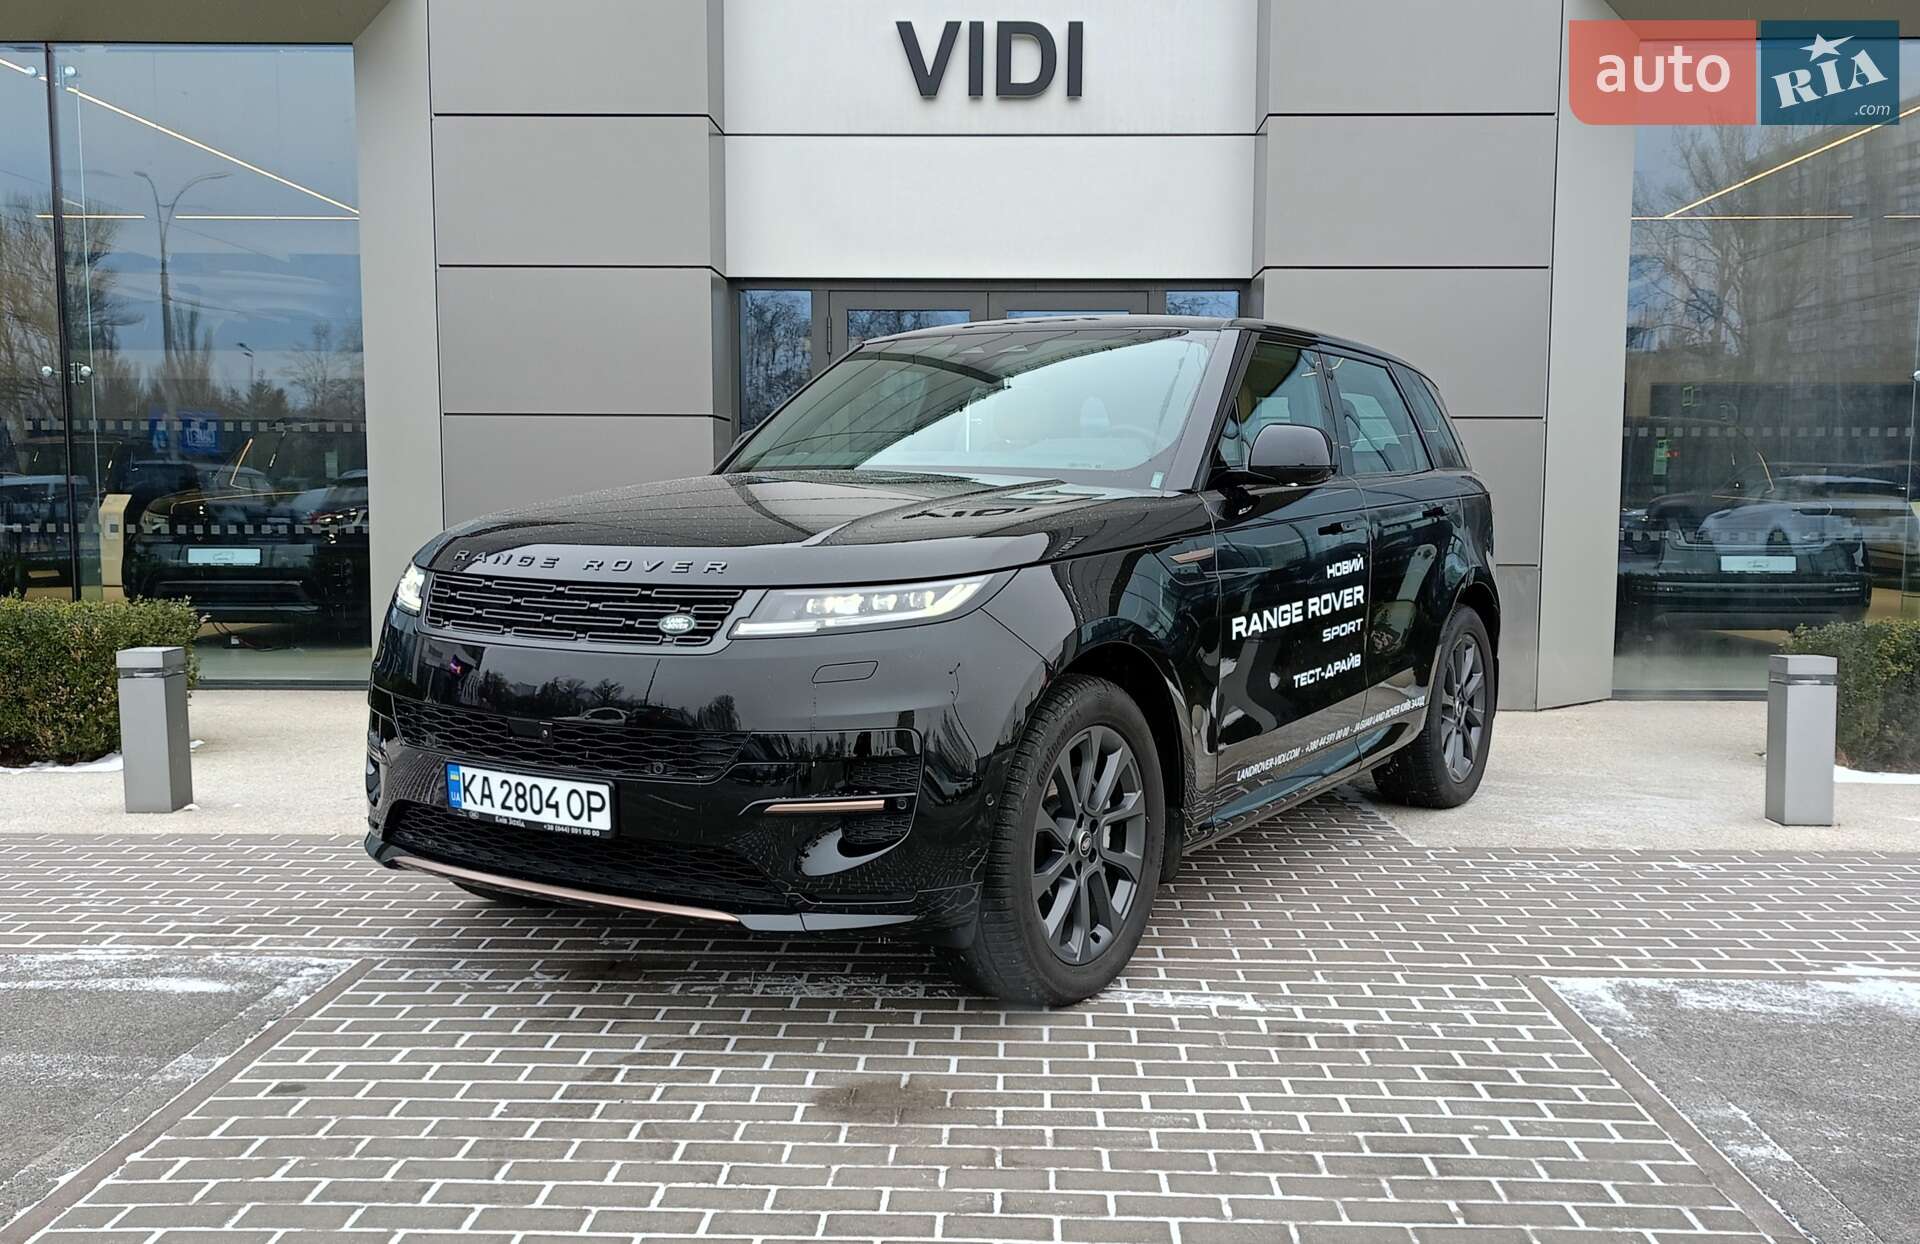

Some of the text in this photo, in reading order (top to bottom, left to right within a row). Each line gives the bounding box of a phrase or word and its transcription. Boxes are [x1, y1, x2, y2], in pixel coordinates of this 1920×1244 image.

[896, 21, 1083, 97] VIDI
[454, 550, 729, 574] RANGE ROVER
[1325, 553, 1364, 579] НОВИЙ
[1231, 585, 1365, 641] RANGE ROVER
[1322, 618, 1364, 642] SPORT
[1293, 652, 1361, 689] ТЕСТ-ДРАЙВ
[462, 772, 495, 808] KA
[500, 779, 560, 819] 2804
